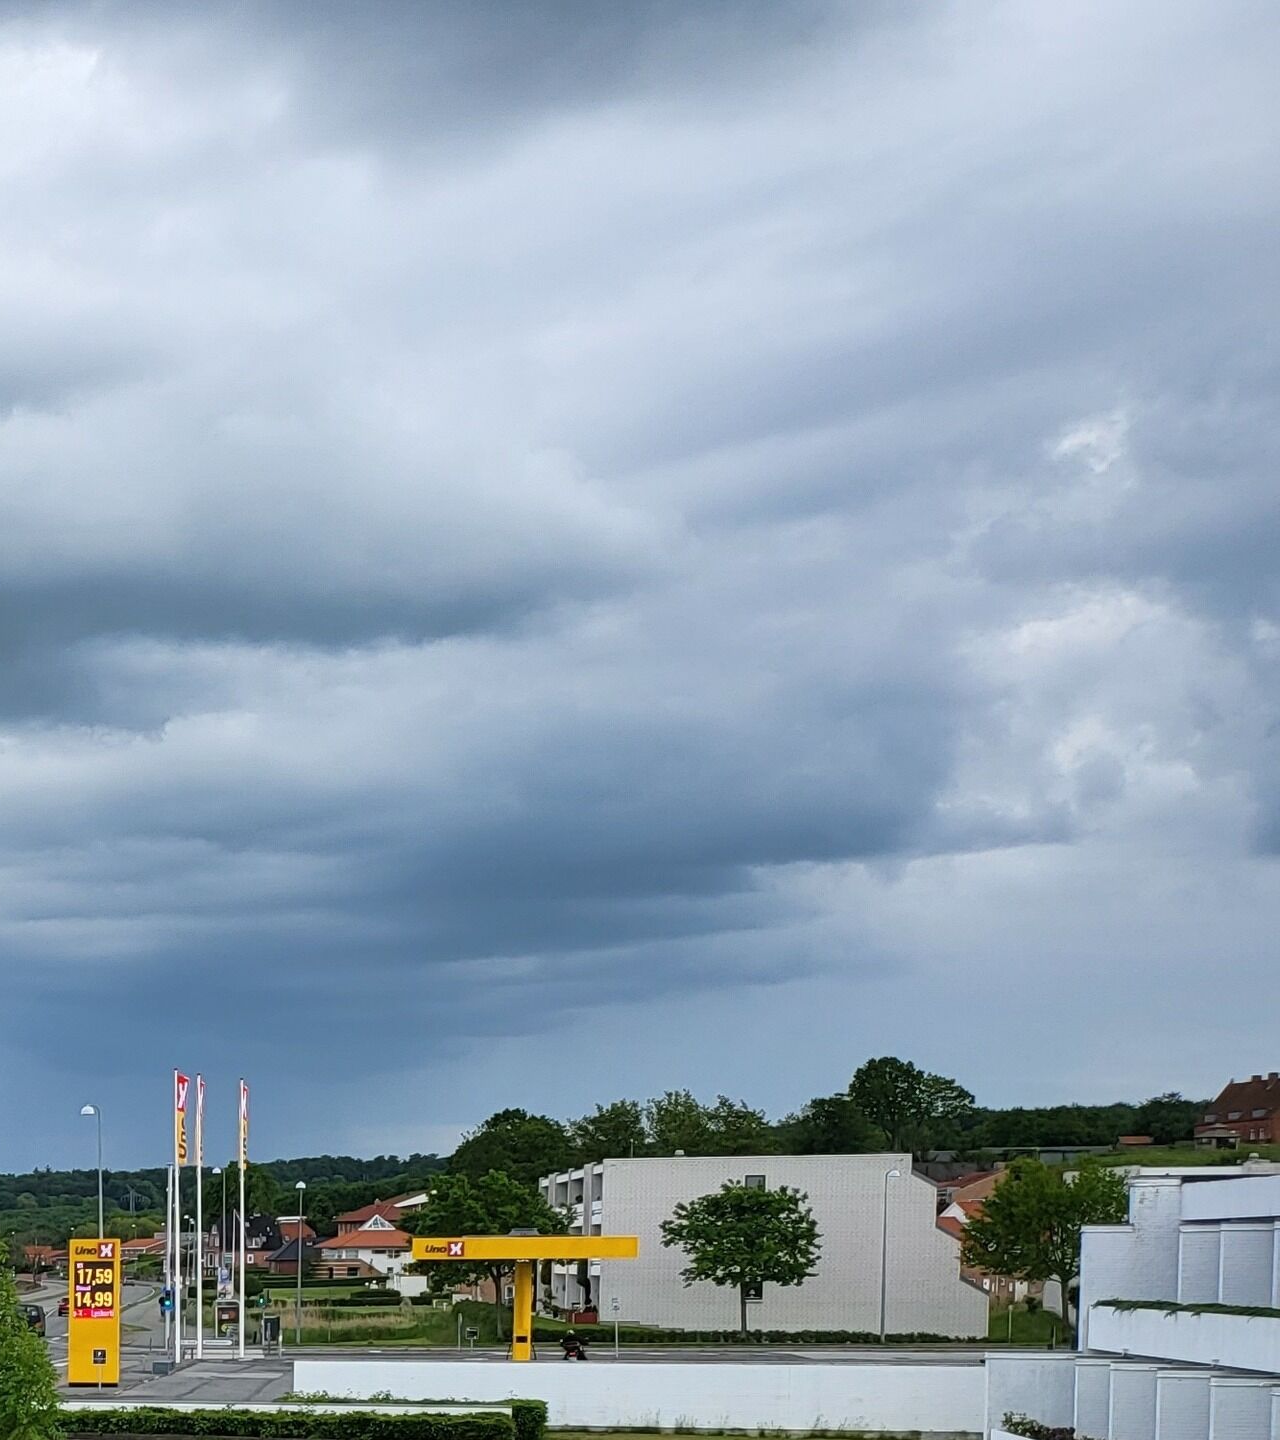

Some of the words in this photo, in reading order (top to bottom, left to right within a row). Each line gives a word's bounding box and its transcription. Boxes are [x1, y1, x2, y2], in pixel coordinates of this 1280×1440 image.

[75, 1246, 97, 1255] Uno
[100, 1243, 114, 1257] X
[425, 1244, 447, 1253] Uno
[449, 1242, 463, 1255] X
[77, 1268, 113, 1286] 17,59
[75, 1291, 113, 1309] 14,99
